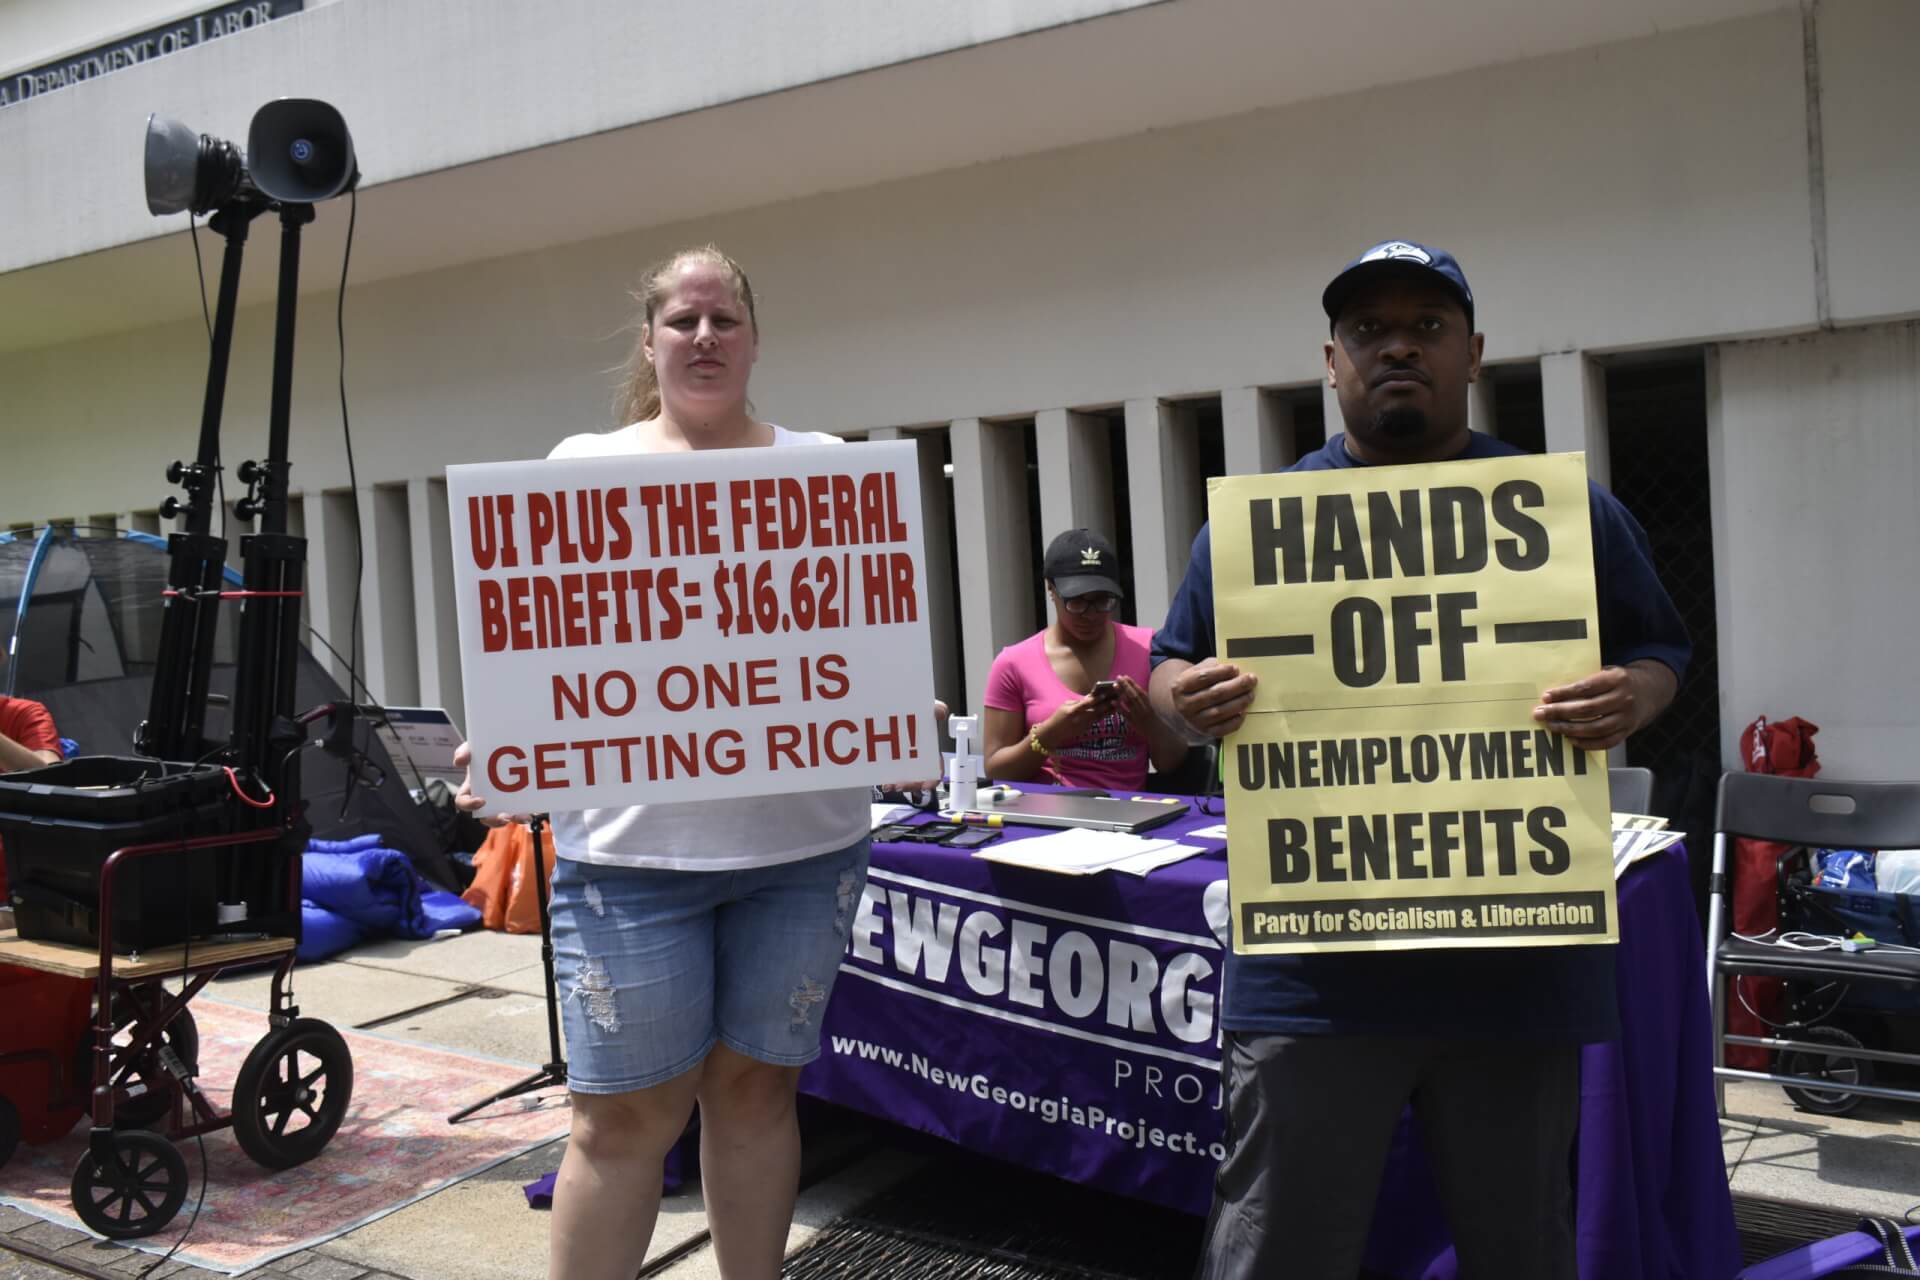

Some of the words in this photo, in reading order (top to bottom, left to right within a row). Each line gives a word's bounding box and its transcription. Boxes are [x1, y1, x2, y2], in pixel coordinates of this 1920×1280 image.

[17, 39, 153, 101] DEPARTMENT
[158, 27, 190, 56] OF
[196, 1, 272, 45] LABOR
[468, 494, 519, 570] UI
[527, 487, 632, 566] PLUS
[640, 481, 721, 558] THE
[730, 472, 907, 553] FEDERAL
[1249, 480, 1551, 586] HANDS
[862, 553, 918, 625] HR
[1331, 591, 1478, 688] OFF
[552, 670, 637, 721] NO
[657, 659, 781, 712] ONE
[800, 654, 850, 702] IS
[487, 729, 746, 793] GETTING
[767, 714, 919, 771] RICH!
[1267, 806, 1571, 884] BENEFITS
[1253, 911, 1309, 935] Party
[1313, 910, 1344, 933] for
[1348, 907, 1457, 932] Socialism
[1461, 909, 1478, 928] &
[1481, 903, 1595, 927] Liberation
[845, 883, 1224, 1049] EWGEORG
